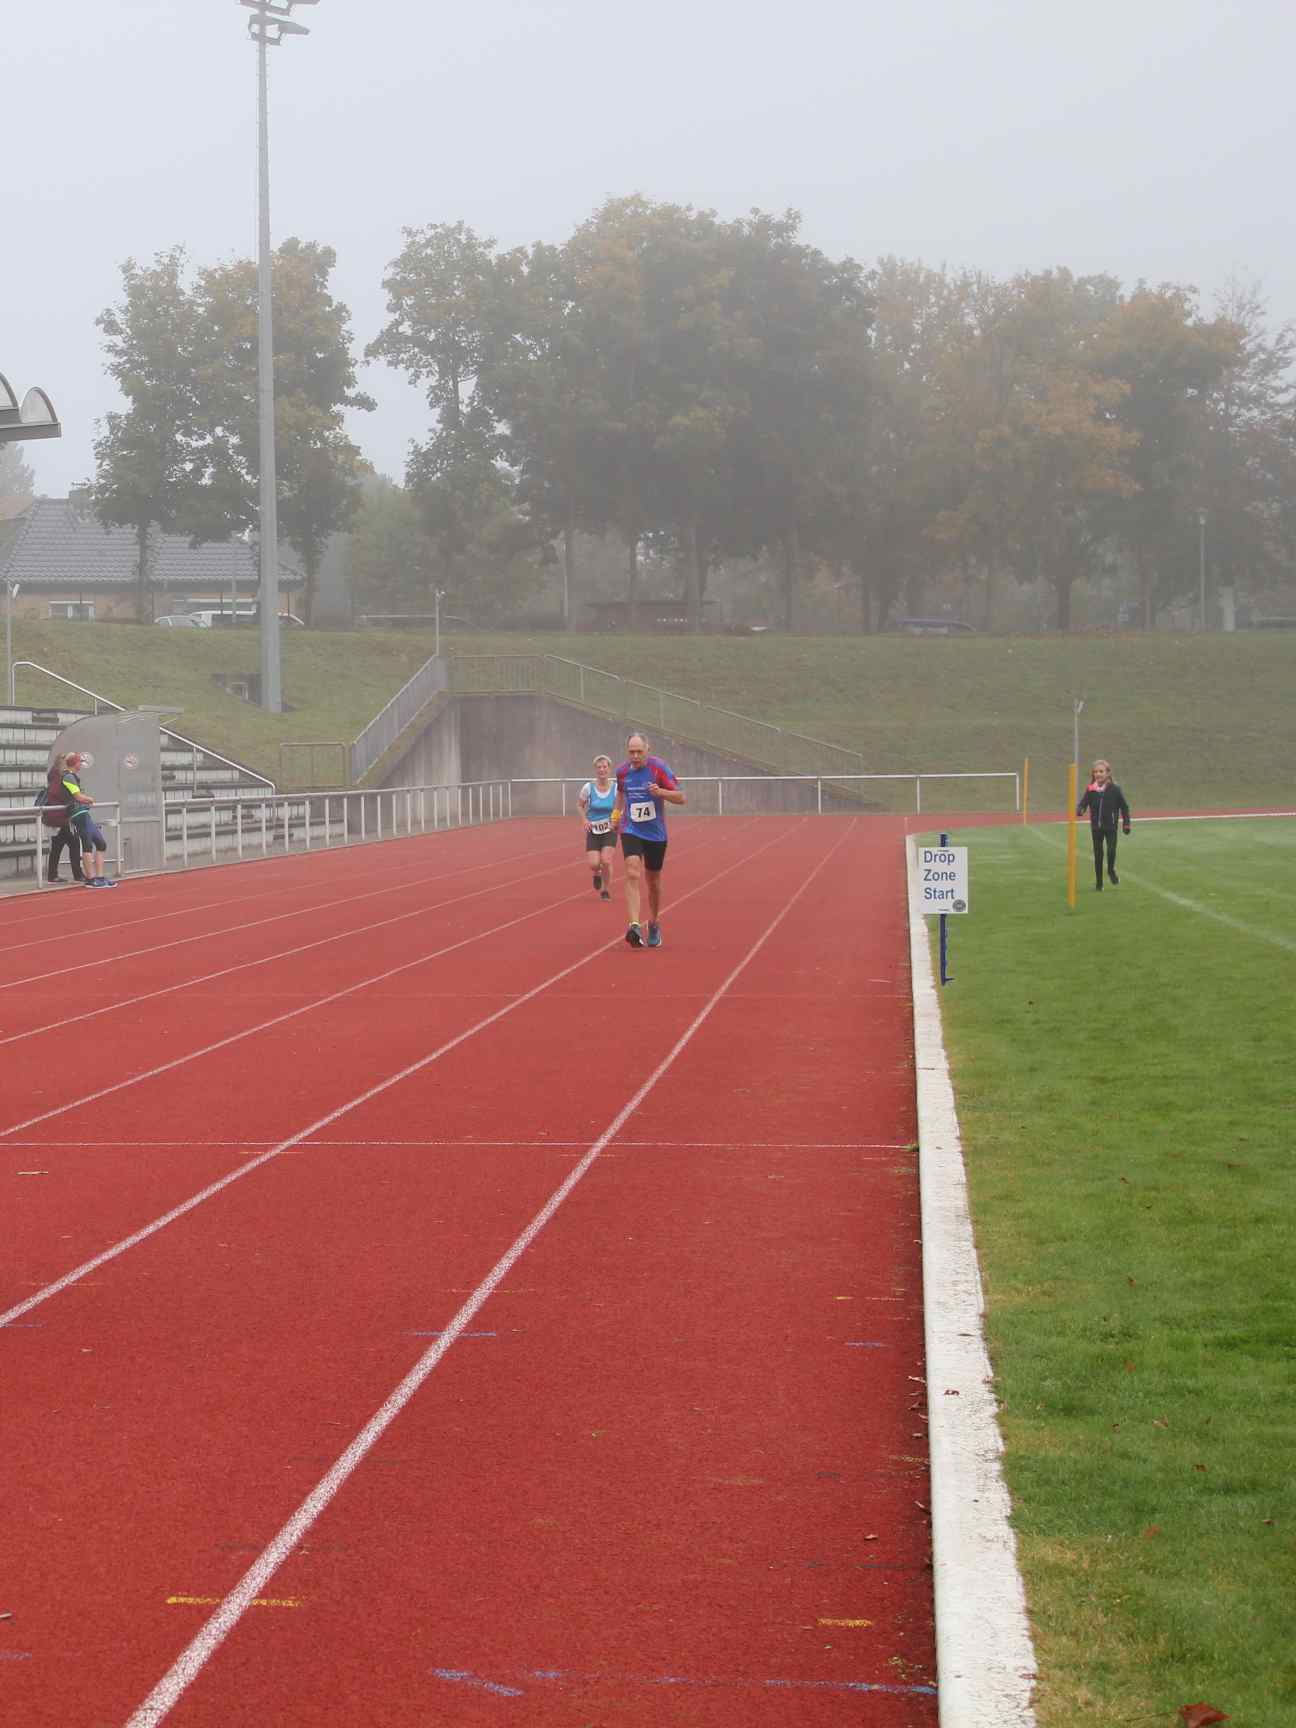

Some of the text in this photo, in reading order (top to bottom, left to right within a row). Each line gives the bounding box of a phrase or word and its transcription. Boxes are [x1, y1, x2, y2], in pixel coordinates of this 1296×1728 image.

[636, 807, 650, 818] 74
[923, 850, 955, 865] Drop
[923, 868, 956, 882] Zone
[924, 887, 955, 900] Start
